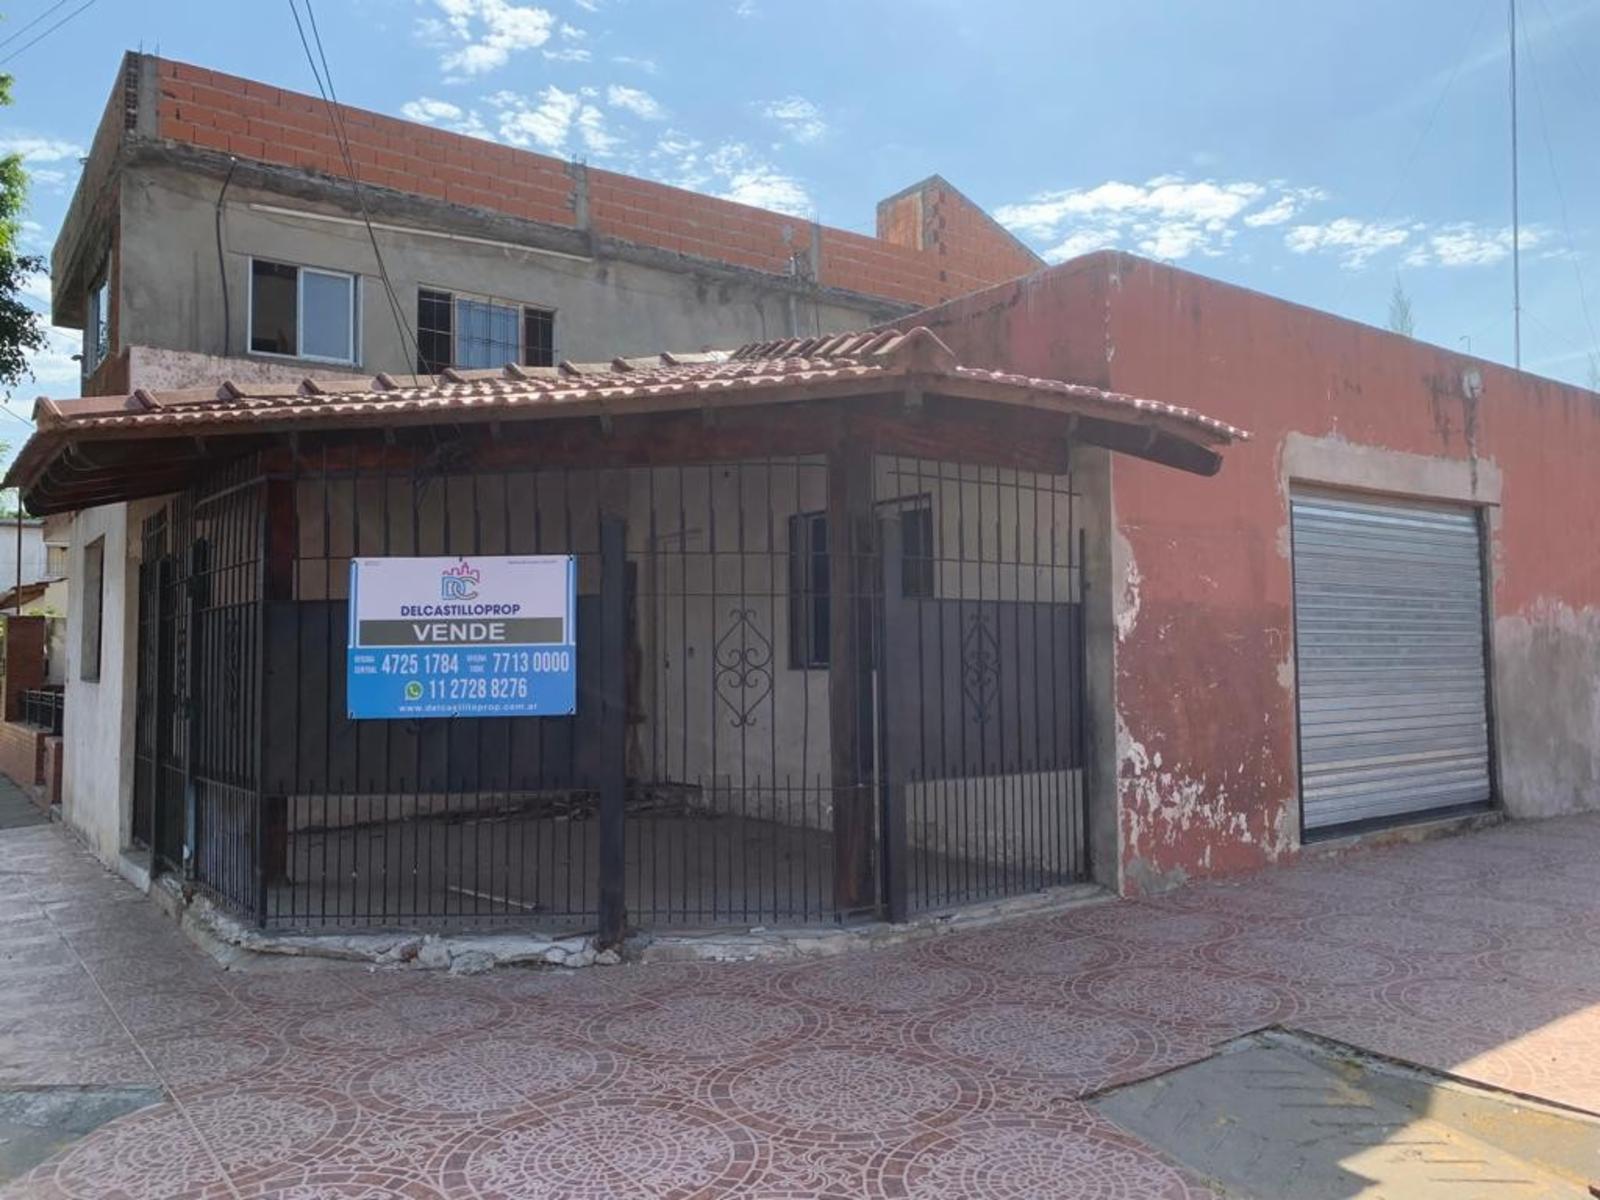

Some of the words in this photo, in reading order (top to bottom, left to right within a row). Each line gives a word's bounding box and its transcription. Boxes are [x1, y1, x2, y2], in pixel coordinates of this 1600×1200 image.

[400, 604, 521, 617] DELCASTILLOPROP
[412, 623, 506, 641] VENDE
[382, 653, 419, 674] 4725
[424, 653, 459, 674] 1784
[492, 652, 529, 673] 7713
[533, 651, 570, 672] 0000
[429, 681, 445, 699] 11
[450, 679, 486, 699] 2728
[490, 678, 528, 698] 8276
